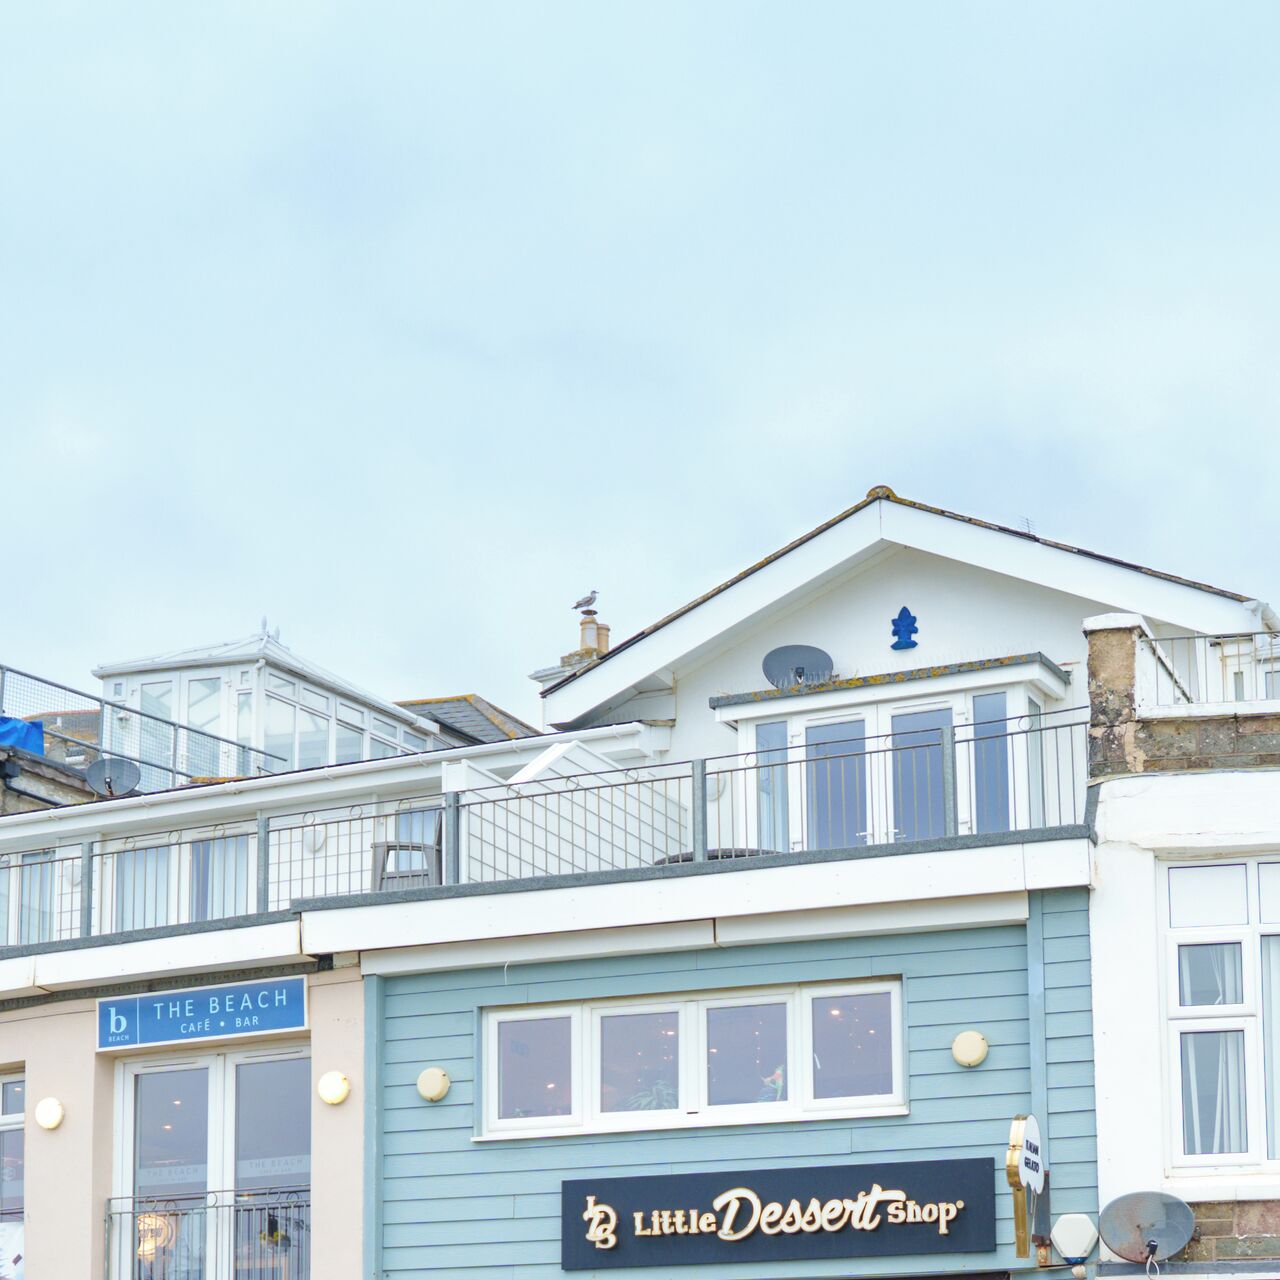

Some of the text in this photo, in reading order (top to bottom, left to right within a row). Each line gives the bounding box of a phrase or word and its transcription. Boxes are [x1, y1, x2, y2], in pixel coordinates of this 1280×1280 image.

[154, 989, 287, 1020] THE BEACH
[108, 1007, 128, 1034] b
[180, 1015, 259, 1034] CAFÉ BAR
[634, 1208, 718, 1237] Little
[712, 1183, 907, 1242] Dessert
